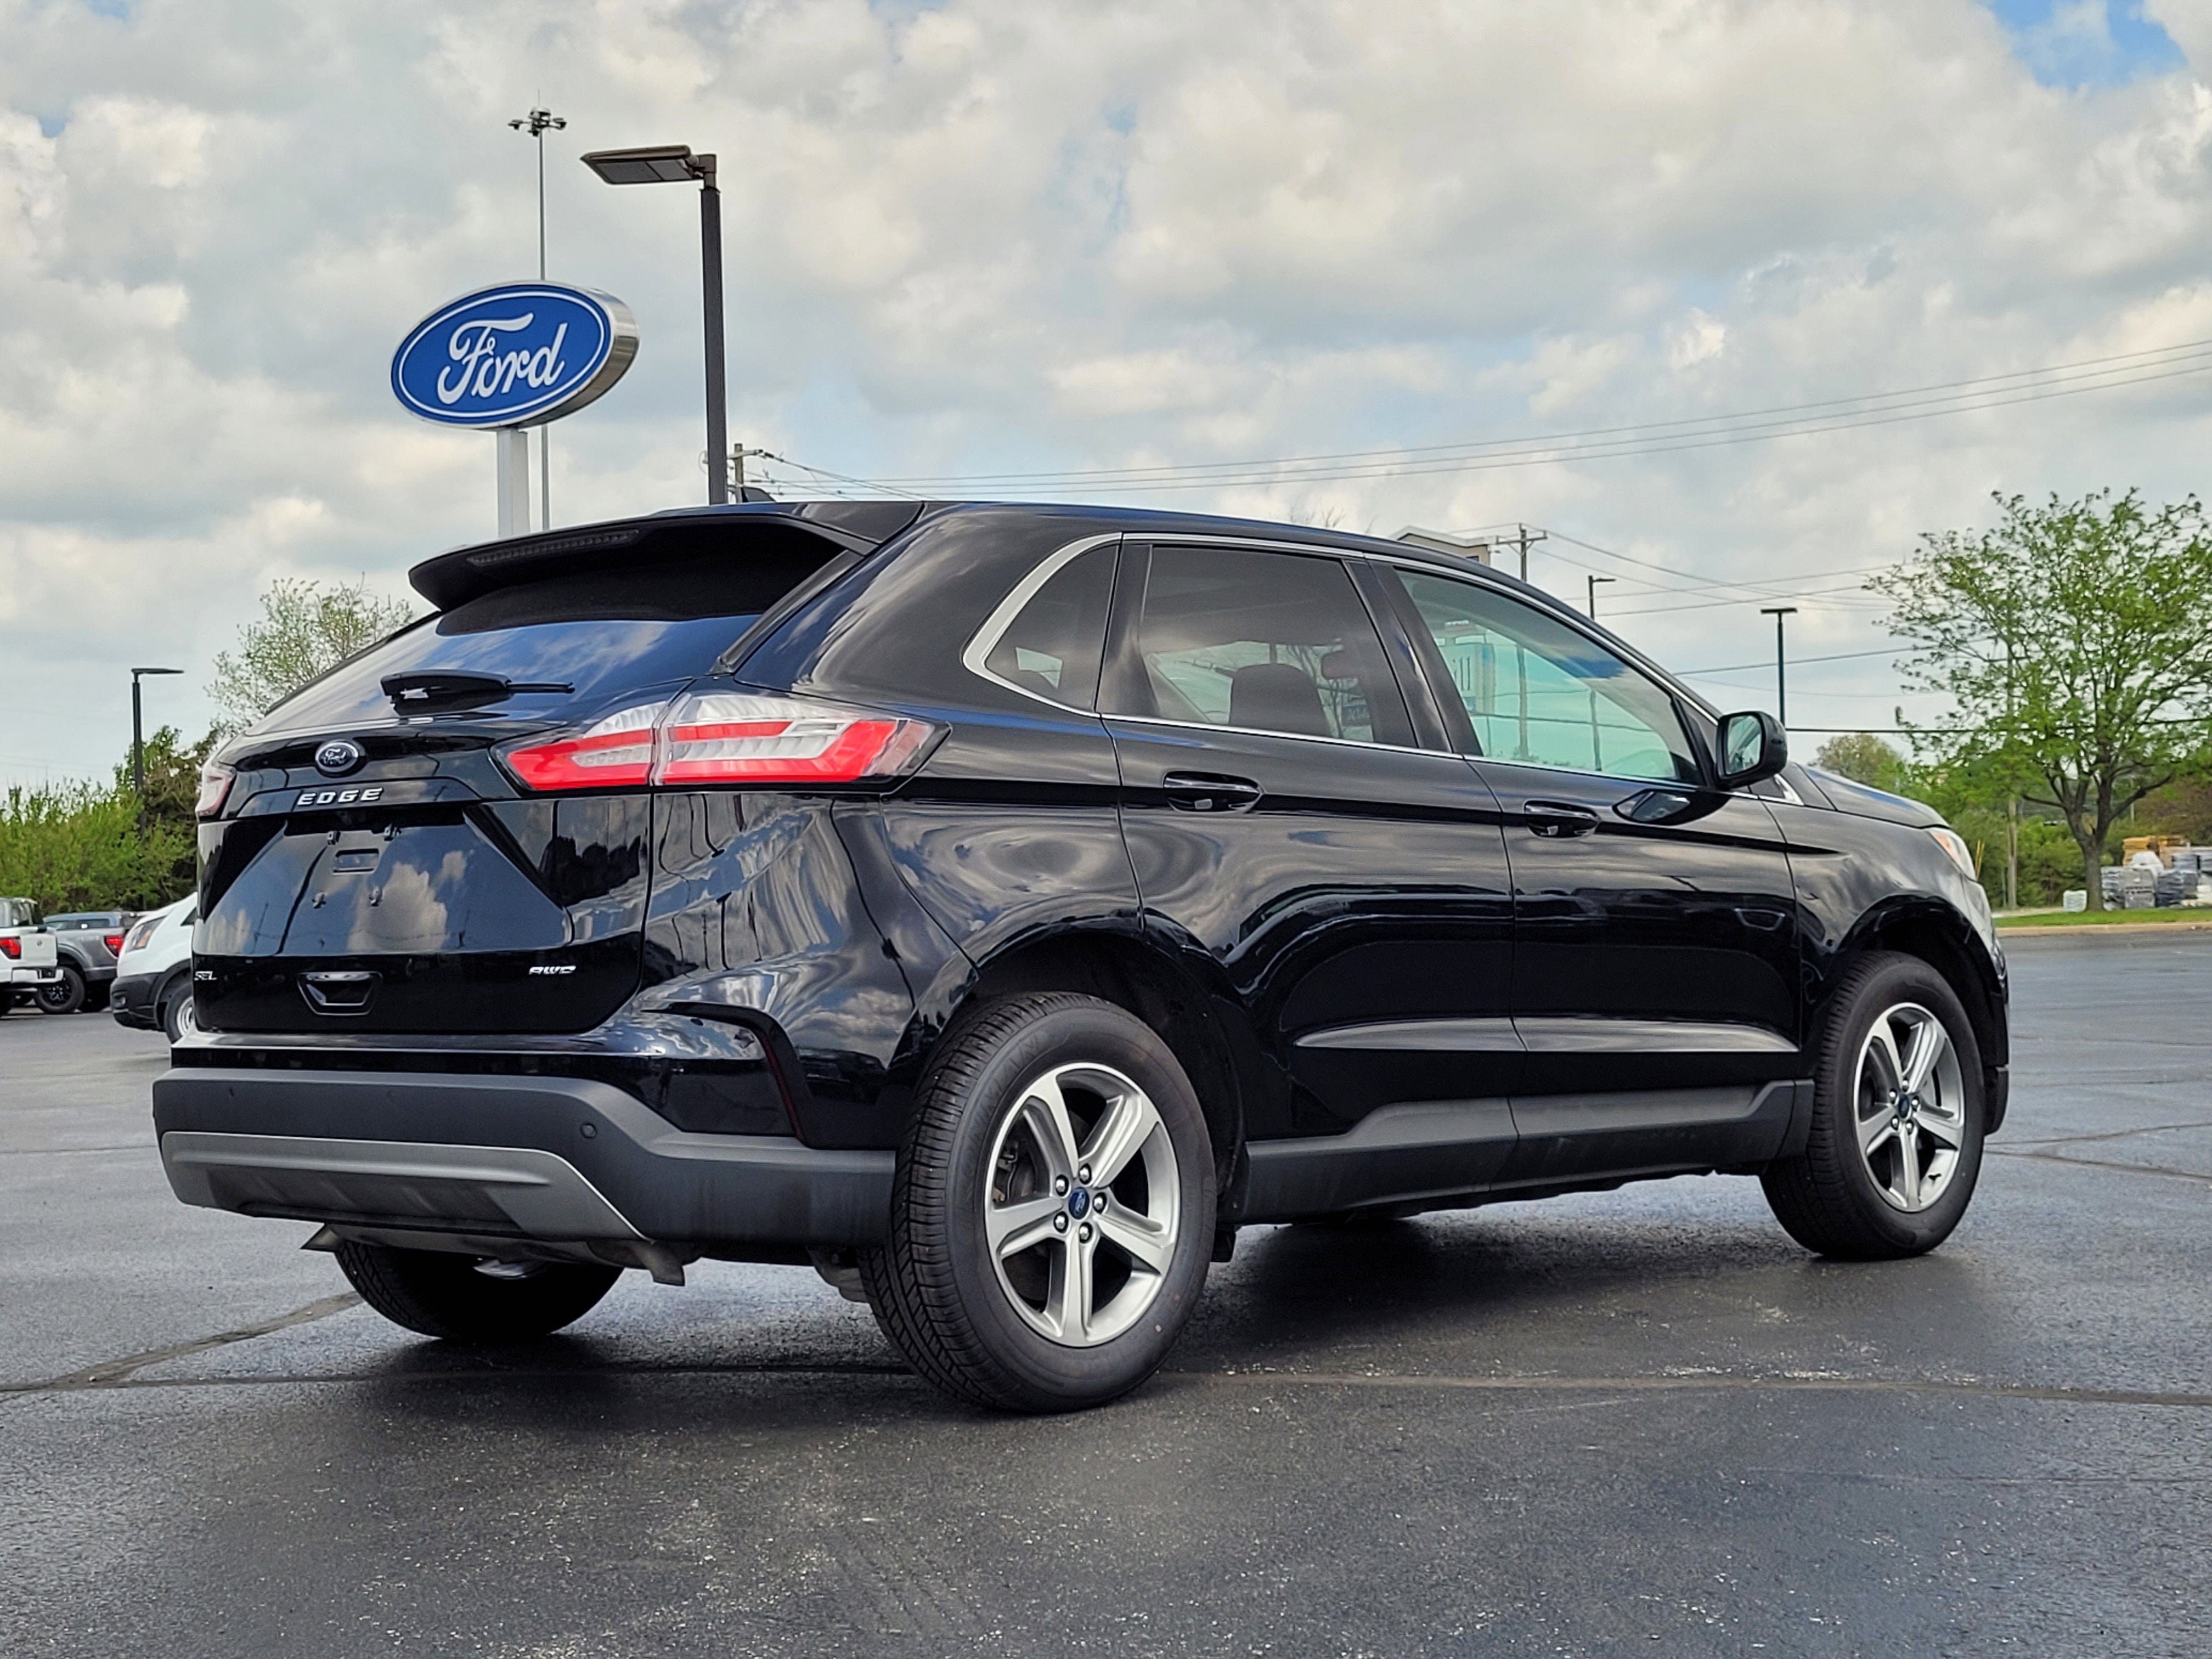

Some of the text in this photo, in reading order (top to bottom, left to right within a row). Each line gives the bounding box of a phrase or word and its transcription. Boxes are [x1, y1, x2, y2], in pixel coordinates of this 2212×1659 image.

[437, 312, 568, 405] Ford
[297, 787, 383, 806] EDGE
[194, 970, 217, 981] SEL
[528, 966, 577, 975] AWD
